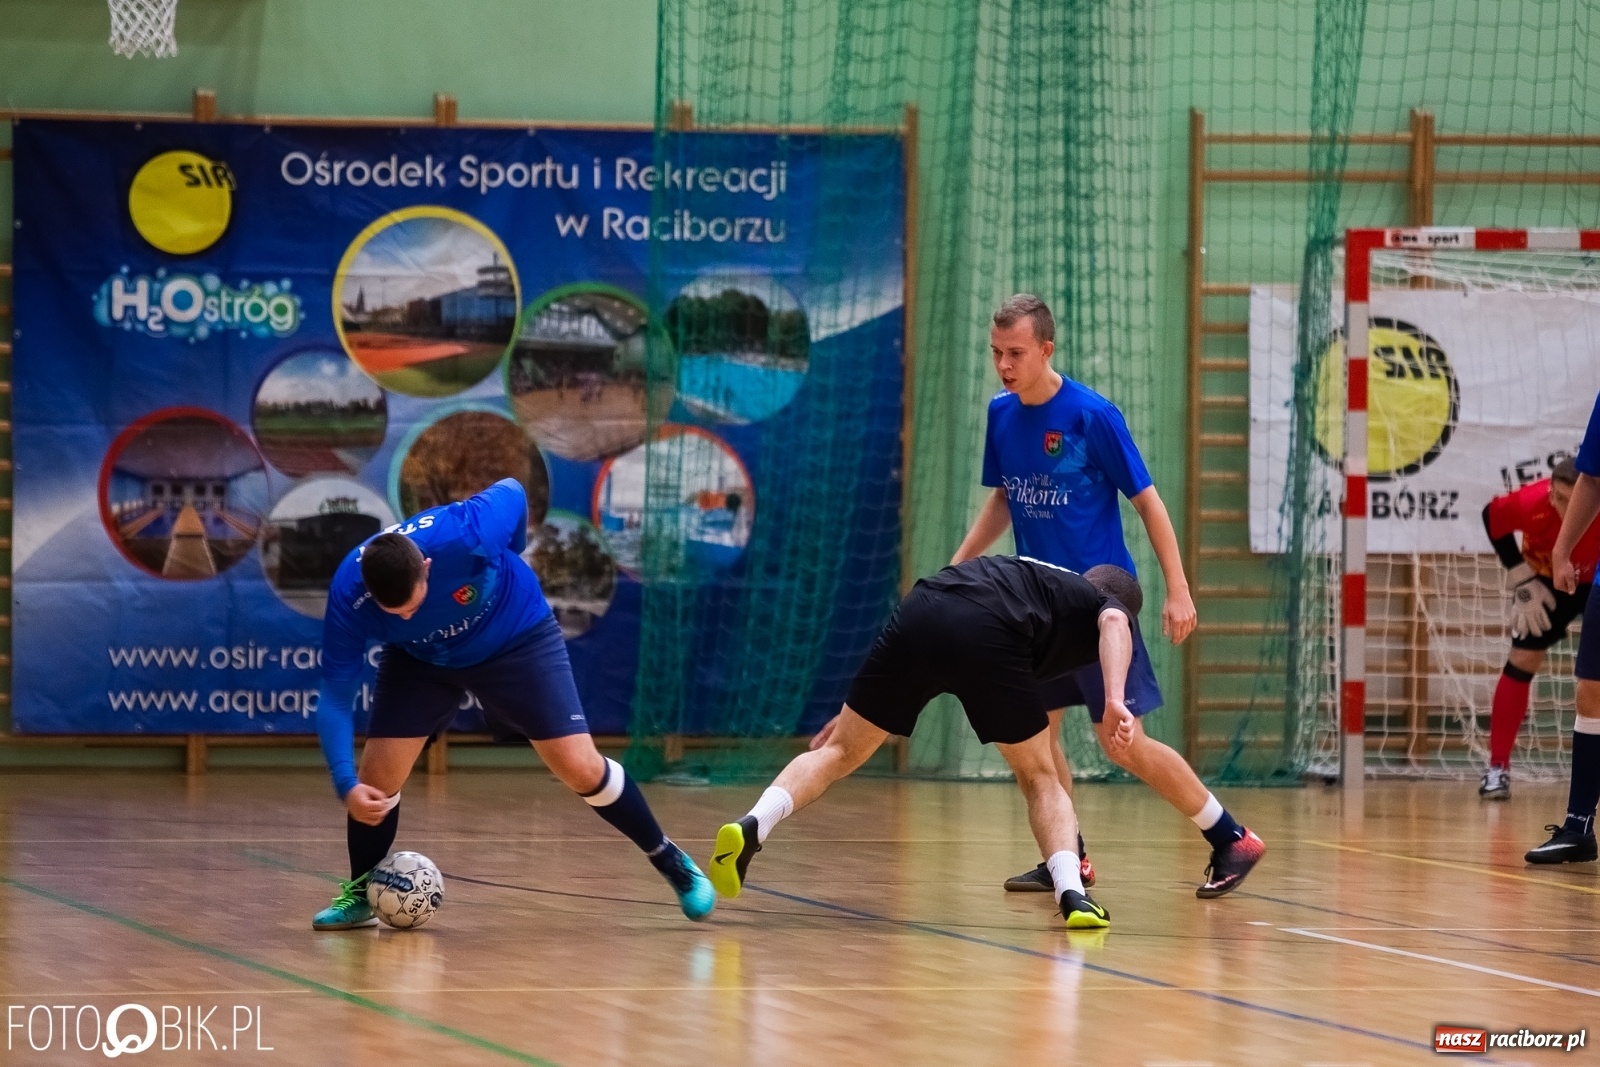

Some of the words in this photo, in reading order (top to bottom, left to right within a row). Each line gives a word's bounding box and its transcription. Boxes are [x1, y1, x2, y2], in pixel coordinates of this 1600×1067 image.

[281, 150, 447, 188] Ośrodek
[458, 154, 580, 195] Sportu
[593, 157, 601, 191] i
[615, 157, 788, 201] Rekreacji
[554, 212, 590, 239] w
[602, 206, 787, 244] Raciborzu
